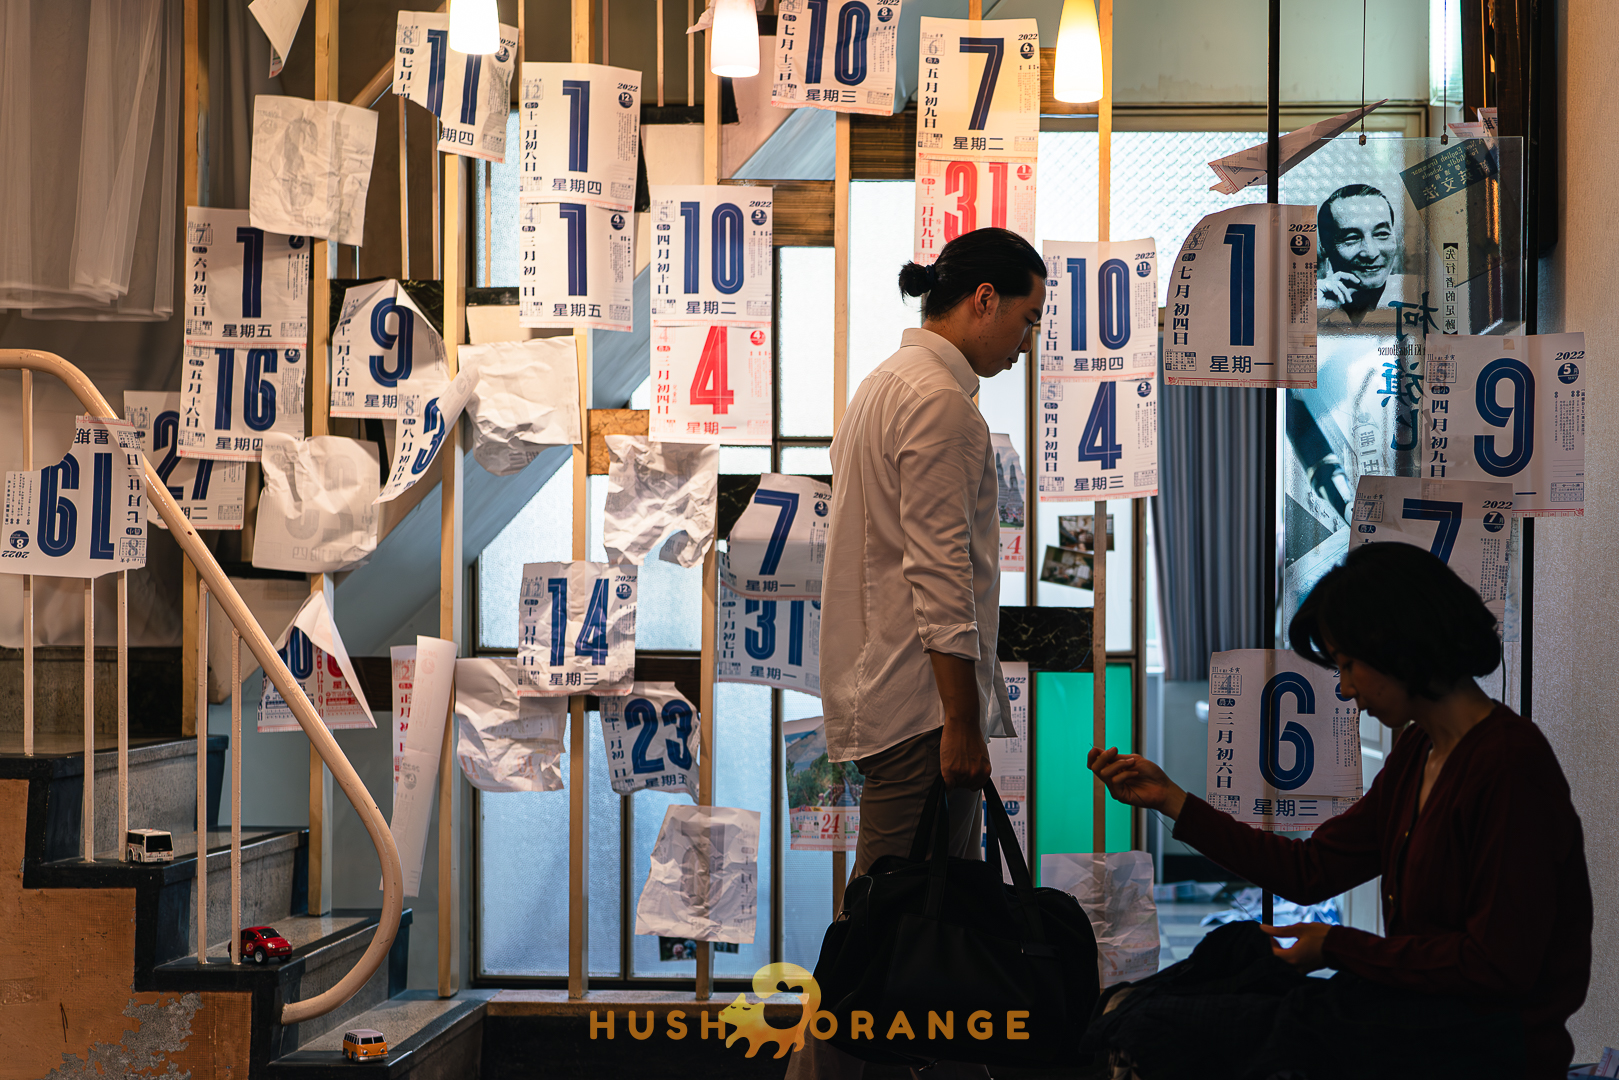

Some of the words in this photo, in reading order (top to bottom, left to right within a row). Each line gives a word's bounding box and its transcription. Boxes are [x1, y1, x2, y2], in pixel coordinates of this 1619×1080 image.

[780, 25, 795, 81] 七月十三日
[805, 0, 870, 86] 10
[427, 29, 482, 126] 11
[617, 82, 638, 92] 2022
[806, 89, 856, 102] 星期三
[925, 68, 938, 128] 五月初九日
[960, 37, 1004, 130] 7
[563, 80, 590, 173] 1
[953, 137, 1004, 151] 星期二
[552, 178, 602, 195] 星期四
[944, 161, 1008, 244] 31
[560, 202, 587, 296] 1
[680, 202, 744, 295] 10
[1135, 252, 1155, 260] 2022
[1289, 224, 1317, 232] 2022
[193, 258, 207, 316] 六月初三日
[236, 227, 264, 318] 1
[523, 236, 536, 296] 三月初一日
[657, 235, 670, 294] 四月初十日
[1223, 224, 1256, 346] 1
[222, 324, 272, 338] 星期五
[553, 304, 602, 318] 星期五
[686, 301, 736, 315] 星期二
[1045, 290, 1058, 350] 十月十七日
[1067, 258, 1131, 351] 10
[1173, 266, 1193, 345] 七月初四日
[369, 297, 414, 388] 9
[690, 326, 734, 415] 4
[1074, 357, 1124, 371] 星期四
[1210, 355, 1274, 373] 星期一
[1555, 351, 1585, 361] 2022
[186, 370, 202, 428] 五月十八日
[214, 348, 278, 432] 16
[365, 394, 397, 408] 星期
[657, 356, 670, 414] 三月初四日
[74, 428, 109, 445] 星期
[216, 437, 263, 451] 星期四
[686, 422, 737, 435] 星期一
[1045, 413, 1058, 472] 四月初四日
[1078, 381, 1122, 470] 4
[1430, 399, 1449, 478] 四月初九日
[1474, 358, 1535, 477] 9
[37, 453, 115, 560] 19
[127, 454, 143, 523] 七月廿二日
[813, 492, 832, 501] 2022
[1074, 475, 1124, 491] 星期三
[1482, 500, 1513, 509] 2022
[2, 550, 30, 559] 2022
[754, 489, 800, 576] 7
[1007, 535, 1021, 554] 4
[1402, 498, 1463, 566] 7
[746, 580, 795, 592] 星期一
[548, 578, 609, 667] 14
[745, 599, 804, 667] 31
[549, 672, 599, 686] 星期三
[750, 665, 797, 680] 星期一
[624, 698, 693, 774] 23
[1216, 711, 1234, 789] 三月初六日
[1259, 672, 1316, 791] 6
[821, 814, 839, 833] 24
[1253, 799, 1318, 817] 星期三
